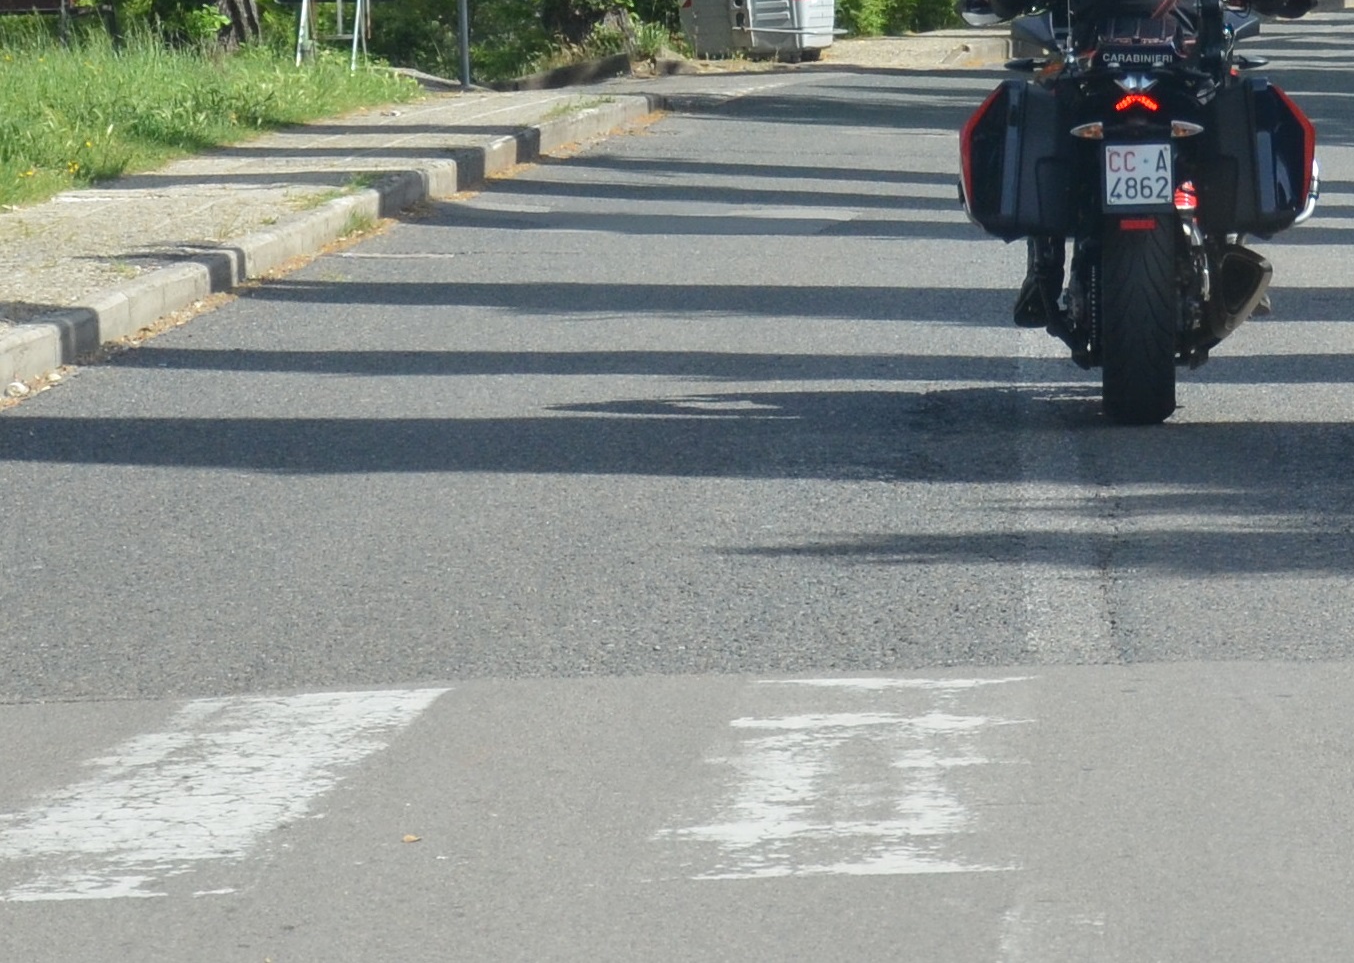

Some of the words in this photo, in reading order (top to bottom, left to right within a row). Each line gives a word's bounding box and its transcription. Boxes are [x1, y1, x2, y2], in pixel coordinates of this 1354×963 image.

[1102, 53, 1173, 63] CARABINIERI
[1108, 151, 1137, 173] CC
[1155, 149, 1168, 173] A
[1109, 176, 1170, 200] 4862
